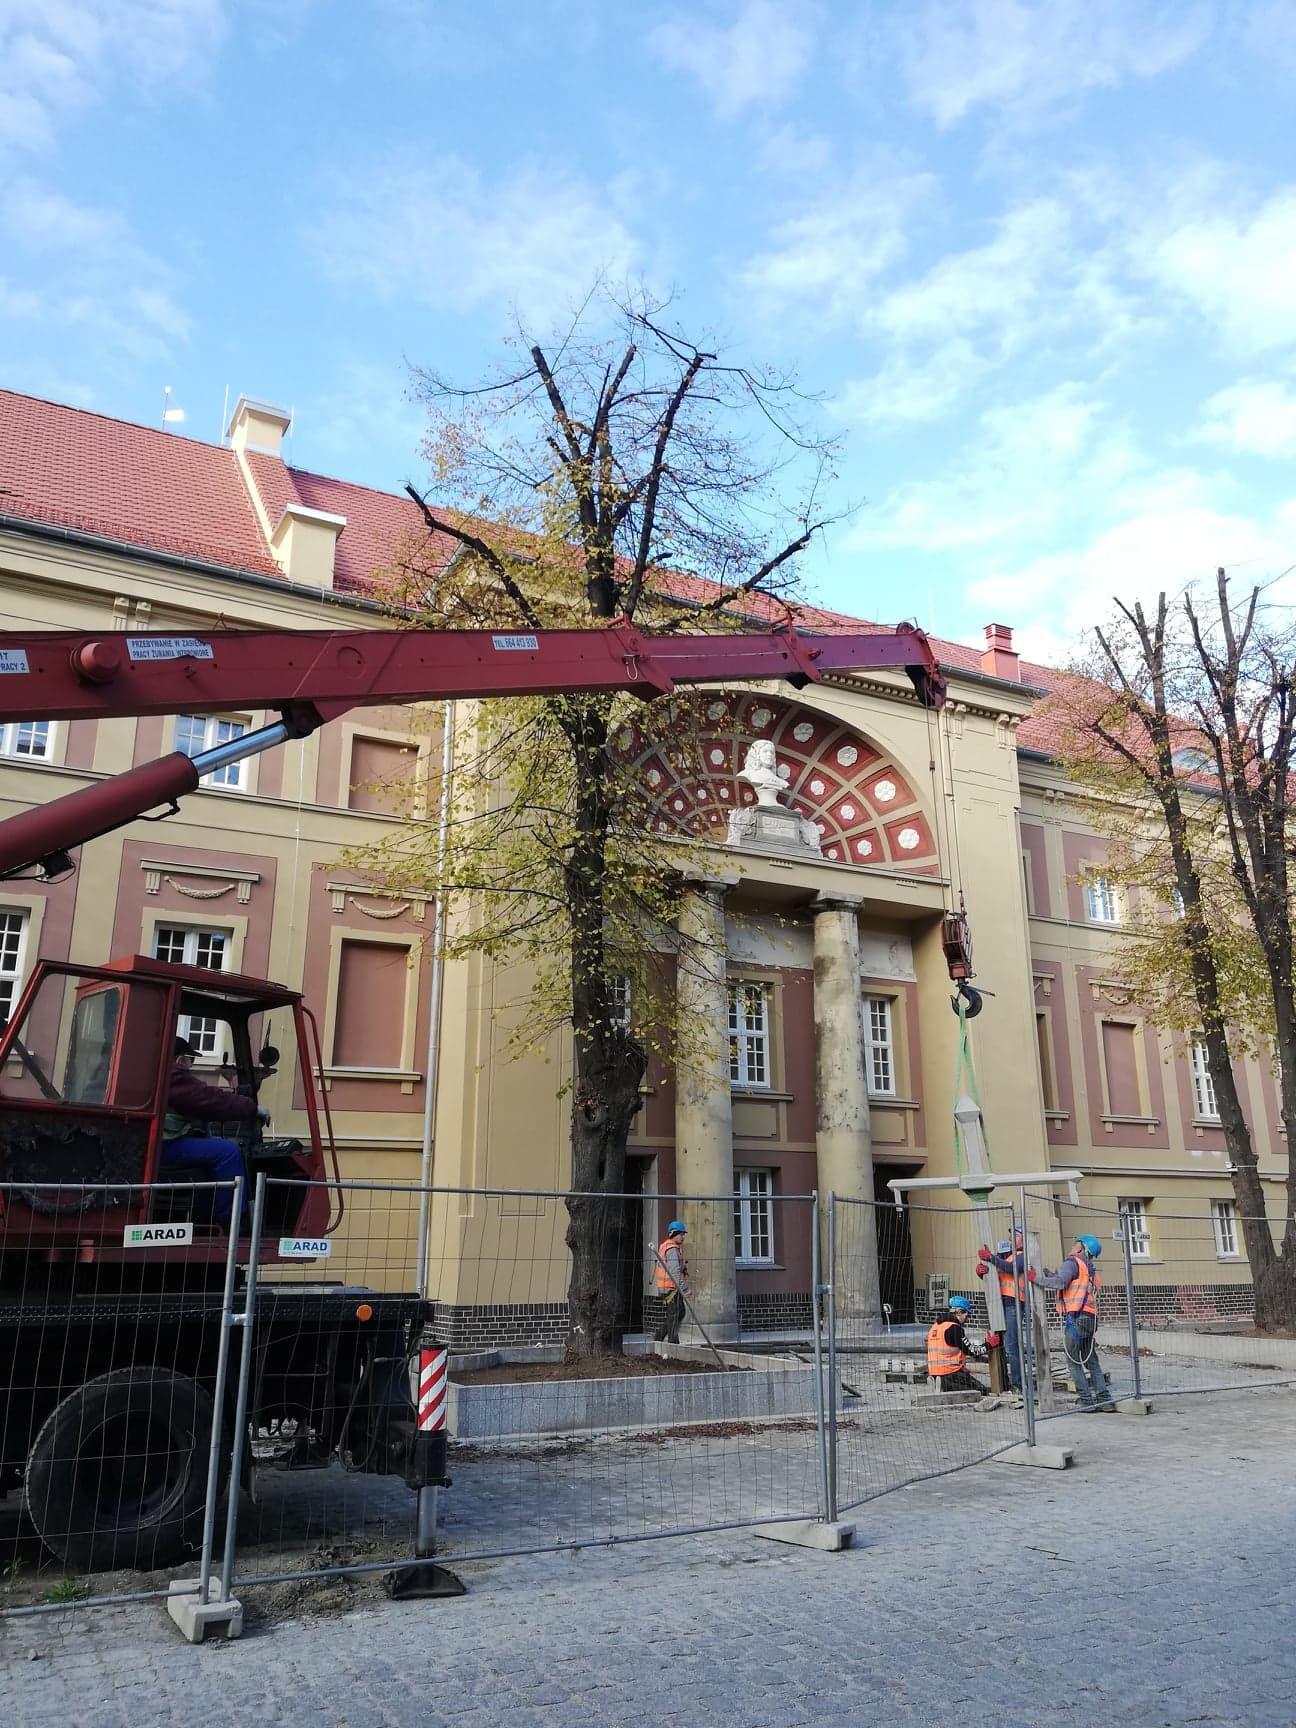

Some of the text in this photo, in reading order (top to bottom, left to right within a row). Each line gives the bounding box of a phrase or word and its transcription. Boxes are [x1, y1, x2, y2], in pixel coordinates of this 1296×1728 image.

[131, 640, 173, 648] PRZEBYWANIE
[175, 640, 180, 648] W
[132, 650, 150, 659] PRACY
[20, 662, 26, 671] 2
[143, 1228, 186, 1241] ARAD
[292, 1241, 328, 1251] ARAD
